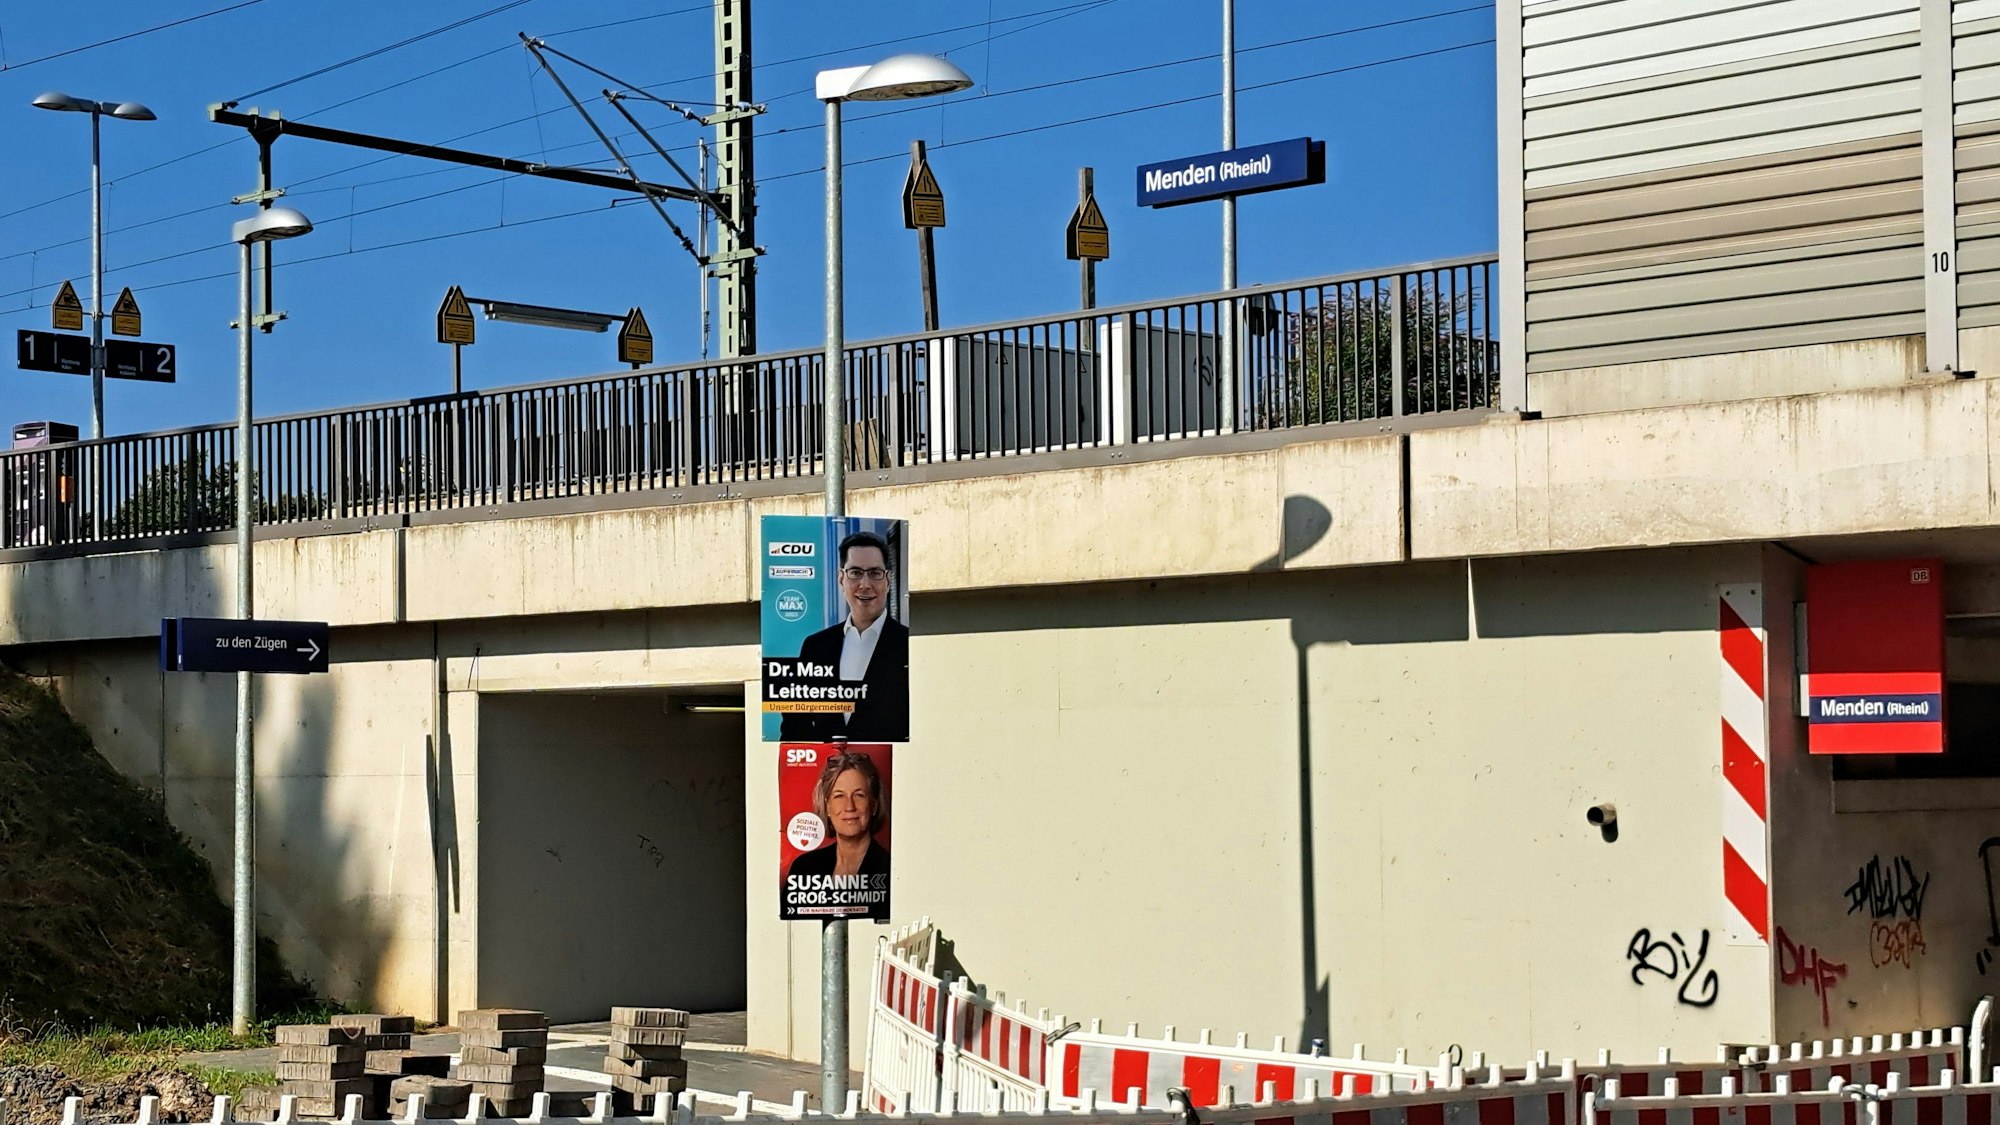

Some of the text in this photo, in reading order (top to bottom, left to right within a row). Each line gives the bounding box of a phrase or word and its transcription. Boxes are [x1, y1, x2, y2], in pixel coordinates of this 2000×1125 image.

[1145, 154, 1271, 192] Menden (Rheinl)
[1932, 251, 1949, 273] 10
[24, 334, 35, 360] 1
[156, 347, 171, 374] 2
[781, 544, 812, 554] CDU
[1913, 571, 1927, 580] DB
[779, 601, 803, 610] MAX
[216, 636, 287, 651] zu den Zügen
[769, 661, 834, 677] Dr. Max
[769, 684, 868, 699] Leitterstorf
[769, 703, 853, 712] Unser Bürgermeister.
[1821, 699, 1929, 717] Menden (Rheinl)
[786, 749, 817, 763] SPD
[796, 818, 818, 826] SOZIALE
[787, 874, 869, 890] SUSANNE
